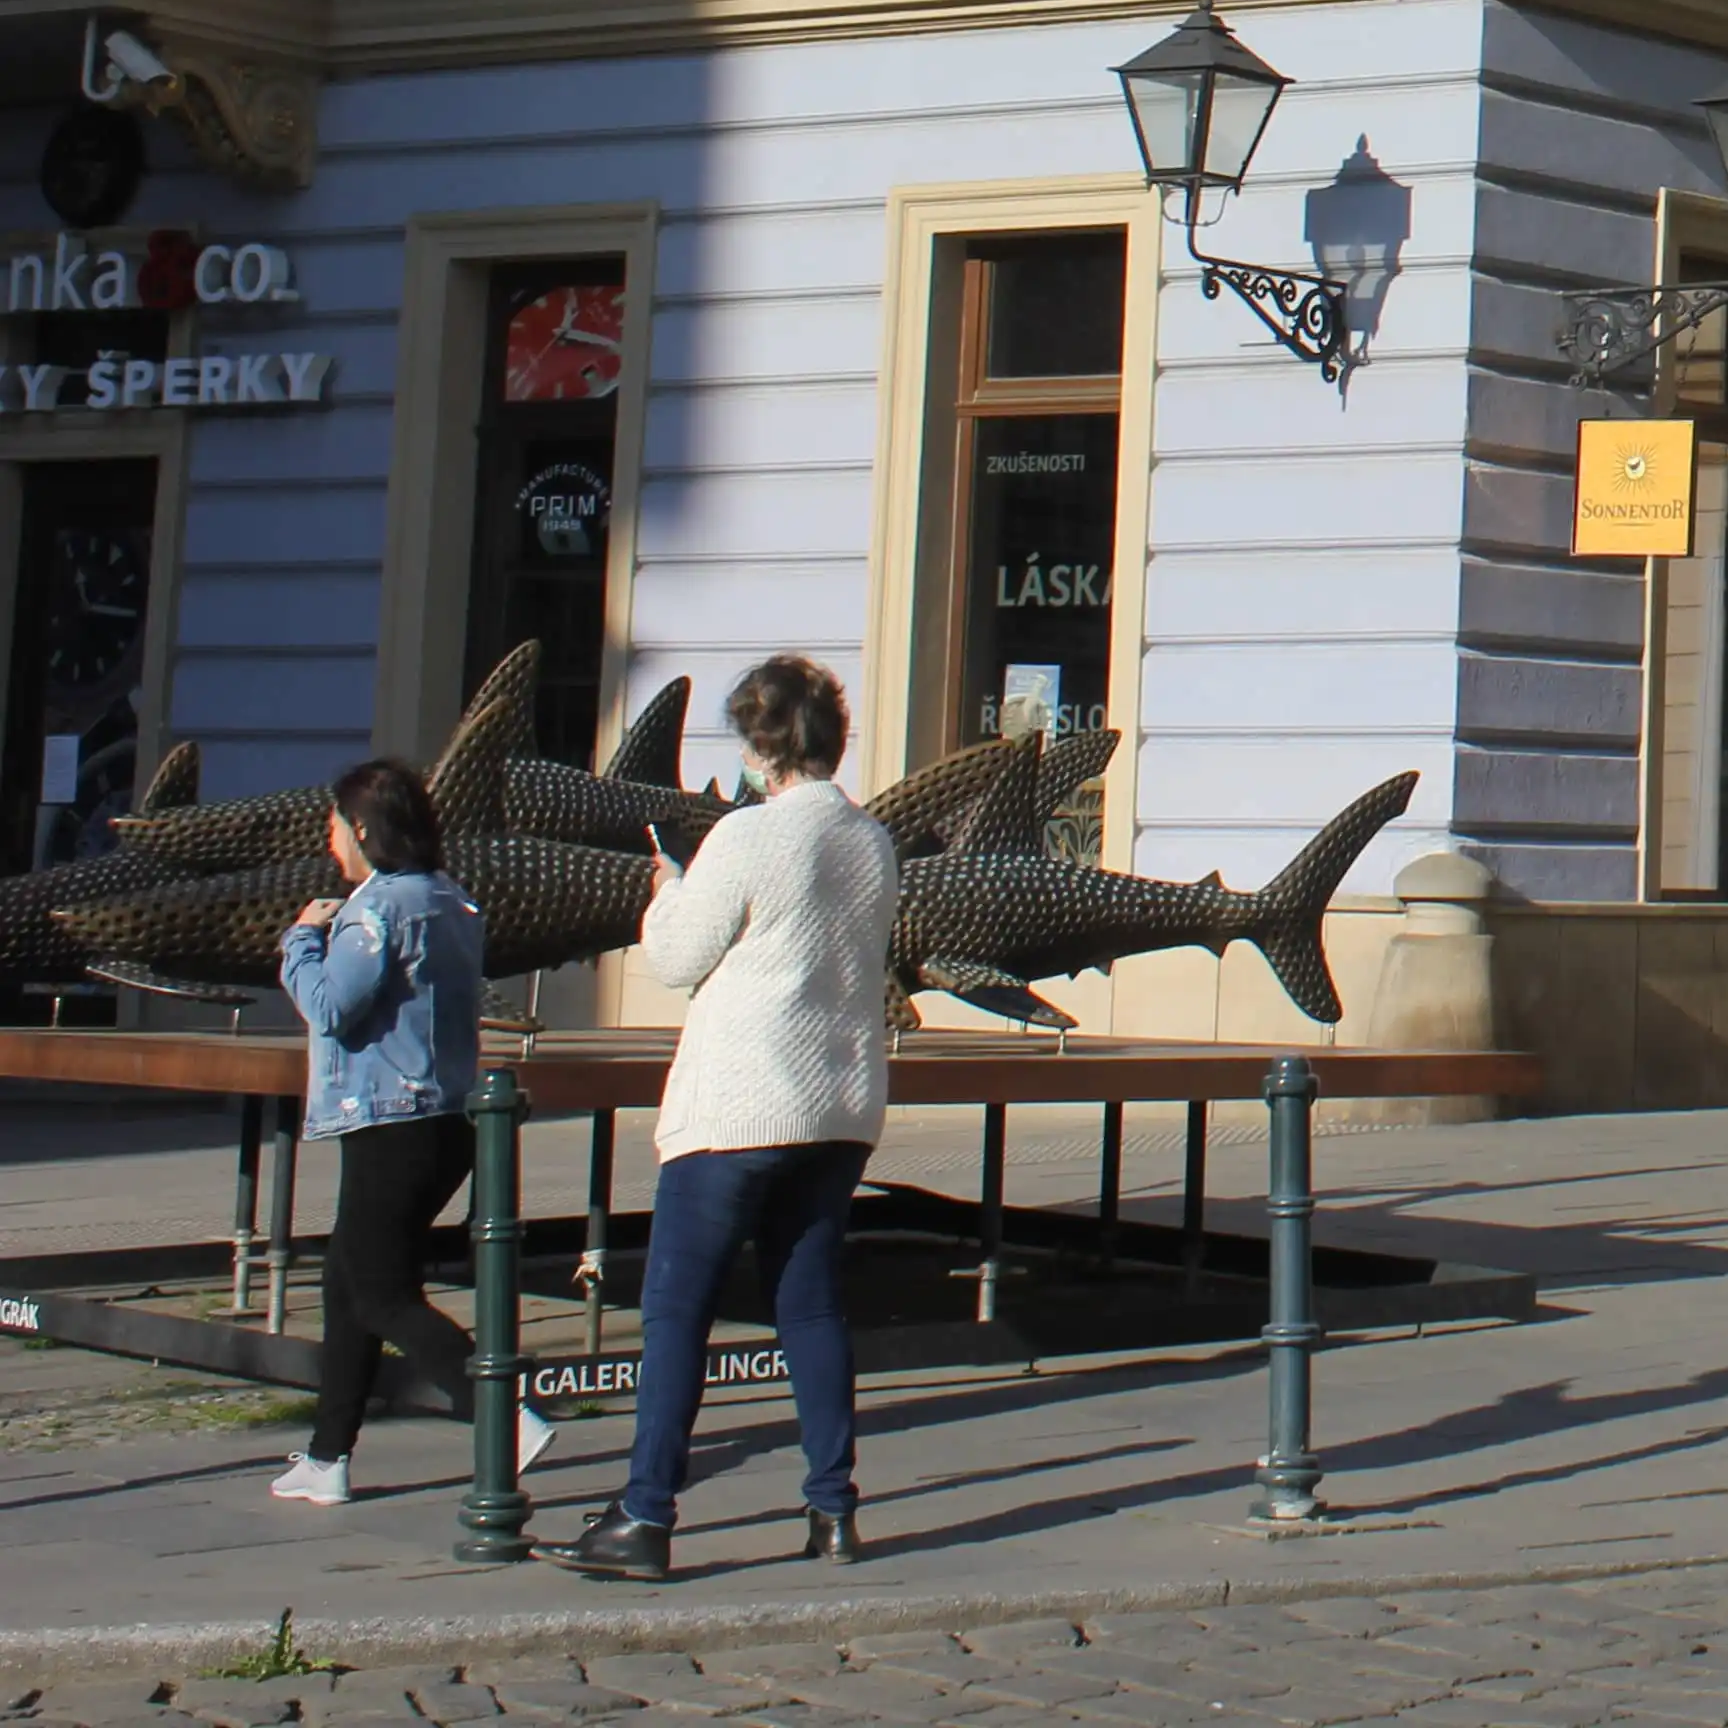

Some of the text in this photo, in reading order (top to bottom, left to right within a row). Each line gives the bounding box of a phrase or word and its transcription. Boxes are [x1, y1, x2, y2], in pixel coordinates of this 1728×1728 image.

[86, 348, 324, 410] ŠPERKY
[986, 450, 1086, 474] ZKUŠENOSTI
[530, 493, 596, 518] PRIM
[1581, 498, 1685, 521] SONNENTOR
[979, 694, 1107, 736] ŘSLO
[0, 1295, 39, 1331] GRÁK
[704, 1349, 790, 1383] LINGR
